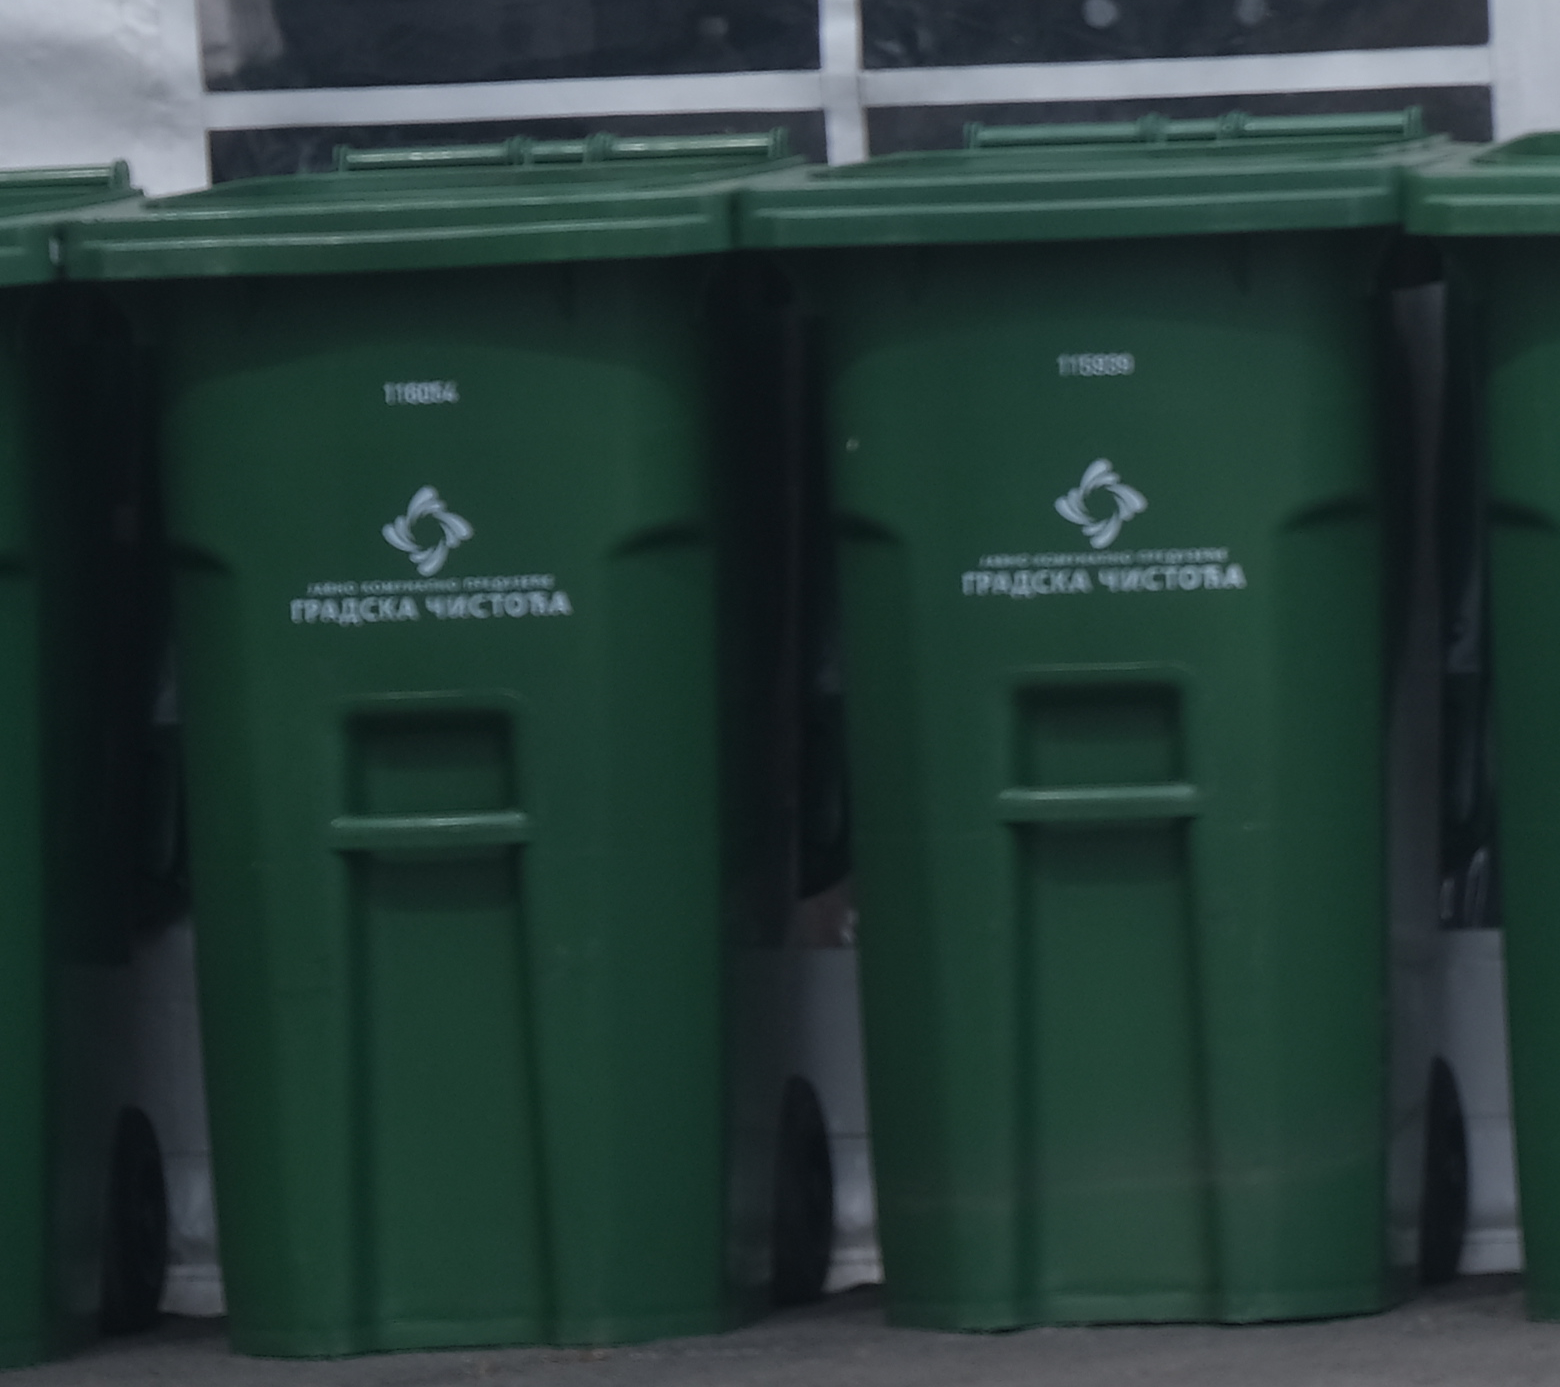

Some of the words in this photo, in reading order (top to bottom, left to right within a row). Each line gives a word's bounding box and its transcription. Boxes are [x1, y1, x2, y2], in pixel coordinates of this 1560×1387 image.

[961, 569, 1093, 599] ГРАДСКА
[1098, 563, 1247, 593] ЧИСТОЋА
[289, 596, 420, 626] ГРАДСКА
[425, 590, 573, 620] ЧИСТОЋА
